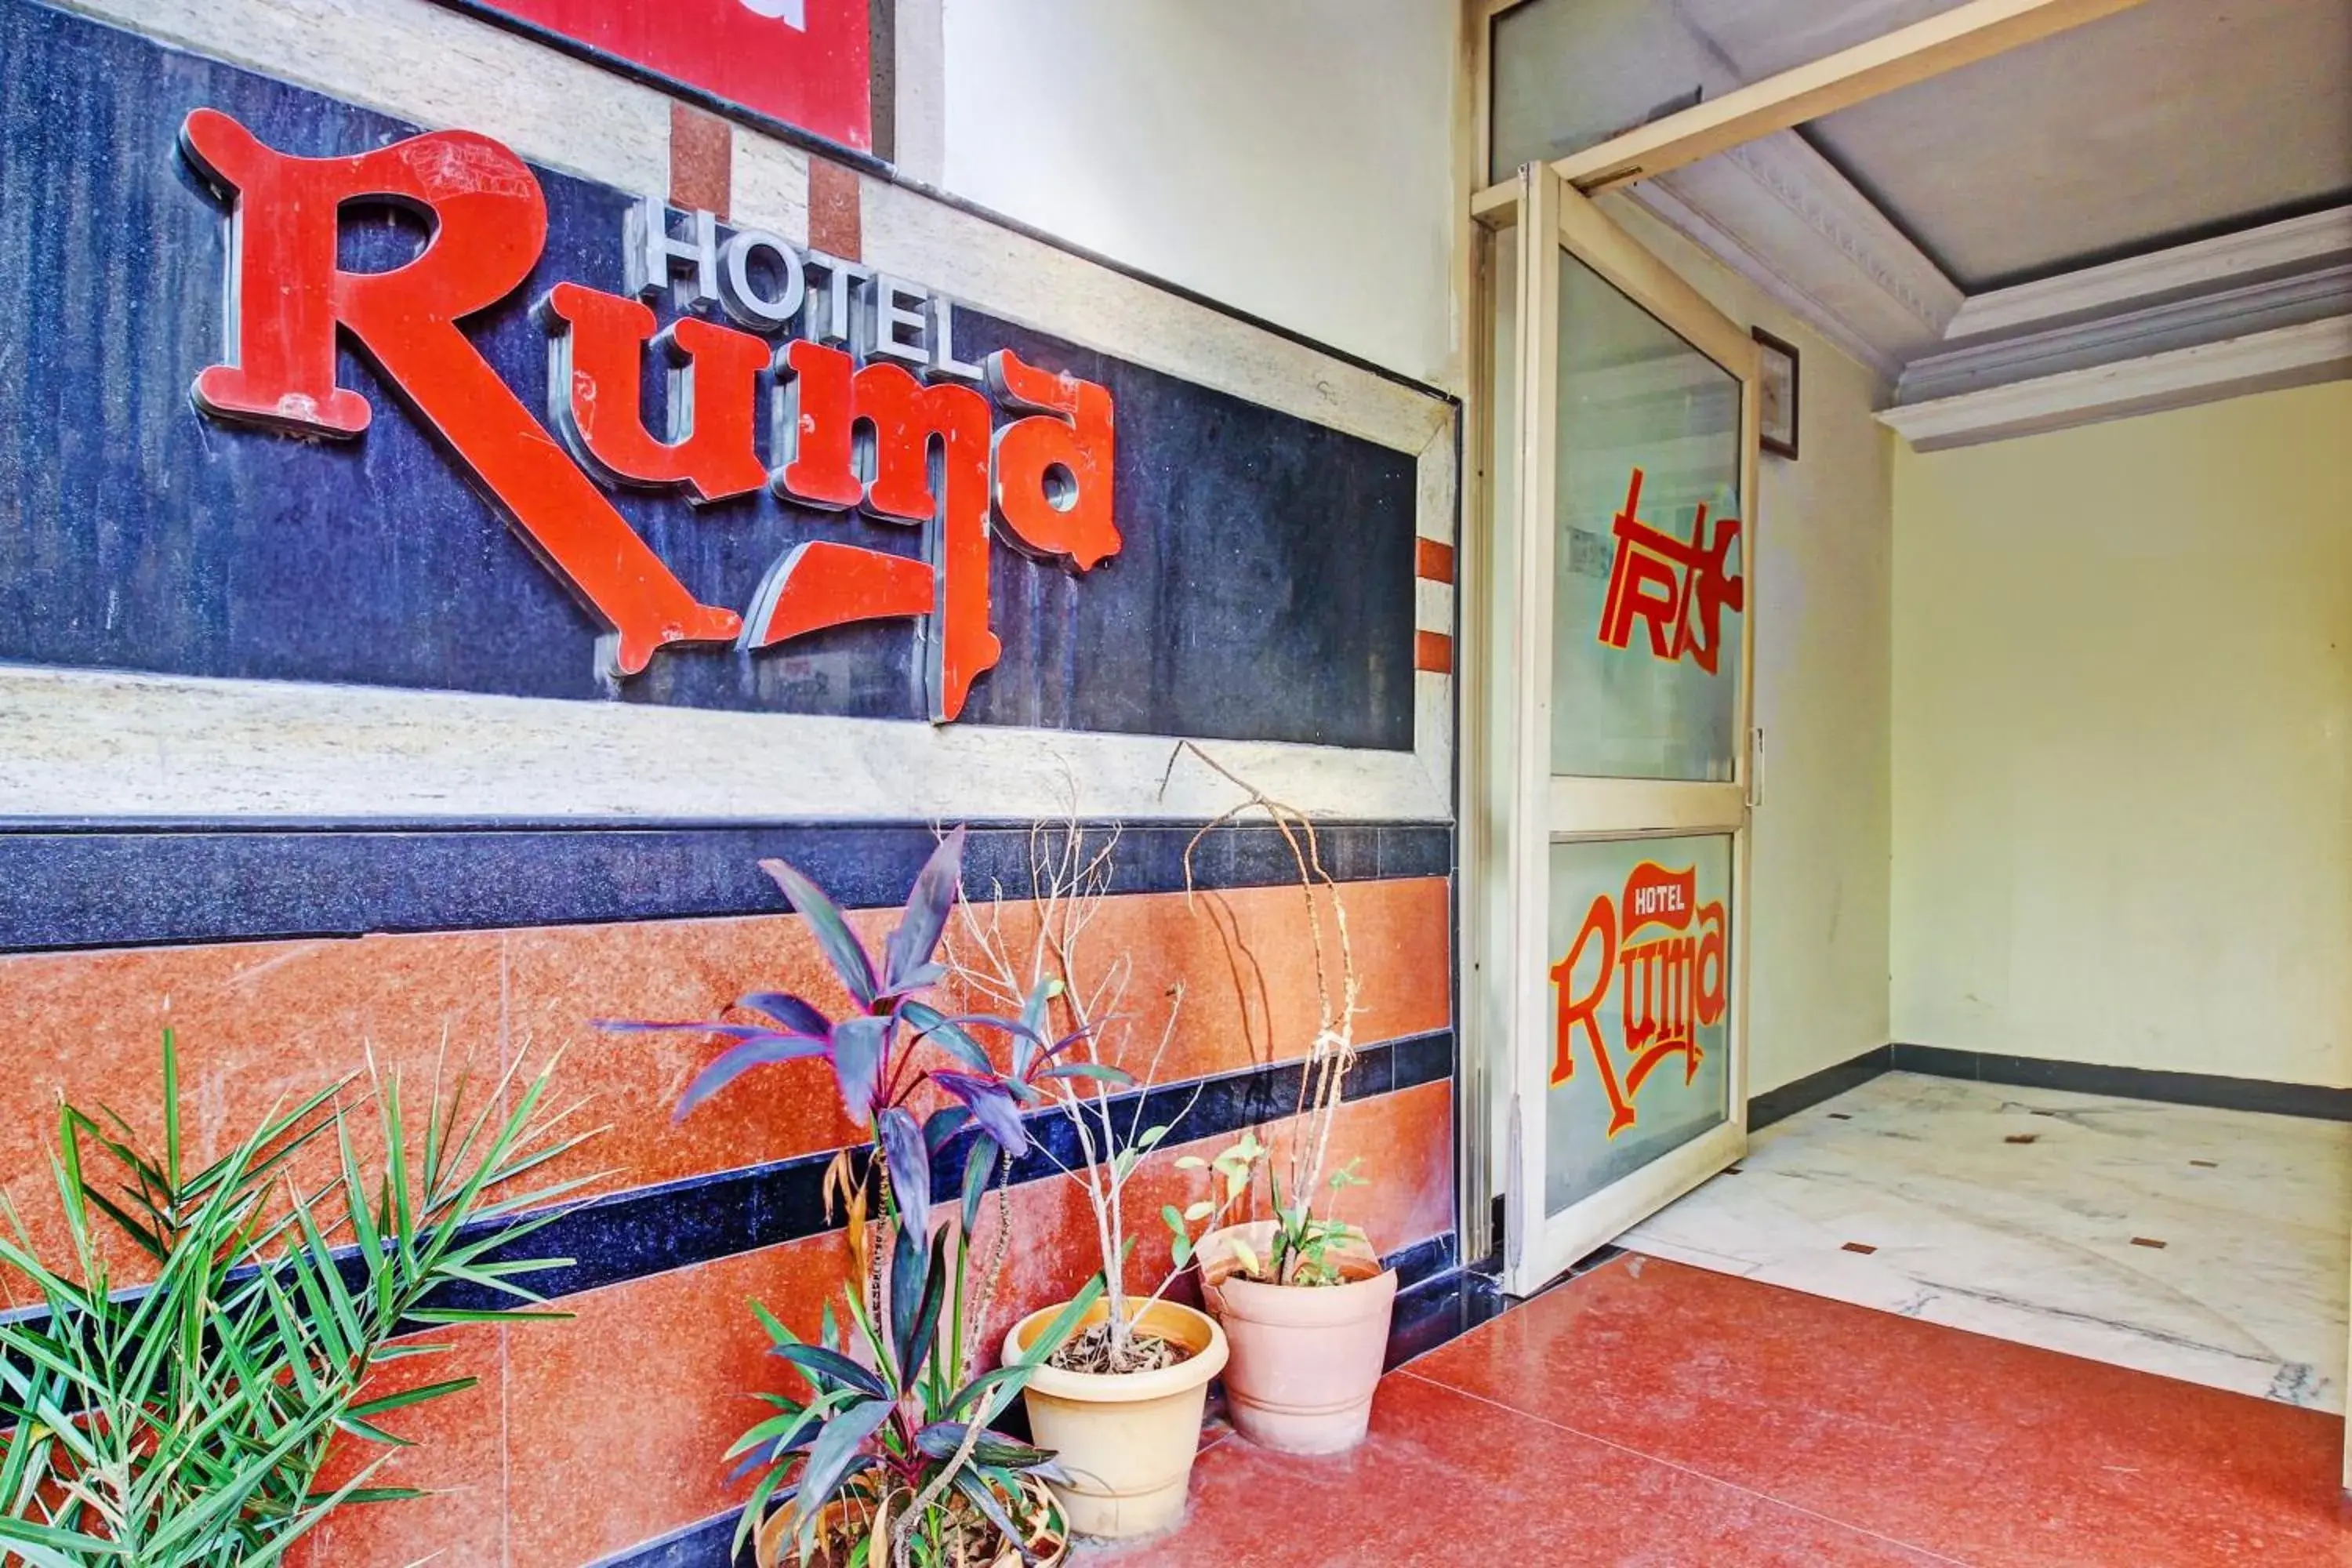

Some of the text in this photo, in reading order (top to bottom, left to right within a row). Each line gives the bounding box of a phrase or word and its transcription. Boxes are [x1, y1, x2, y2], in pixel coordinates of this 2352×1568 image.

[644, 196, 985, 380] HOTEL
[182, 107, 1122, 723] Ruma
[1635, 884, 1685, 916] HOTEL
[1549, 894, 1726, 1139] Ruma
